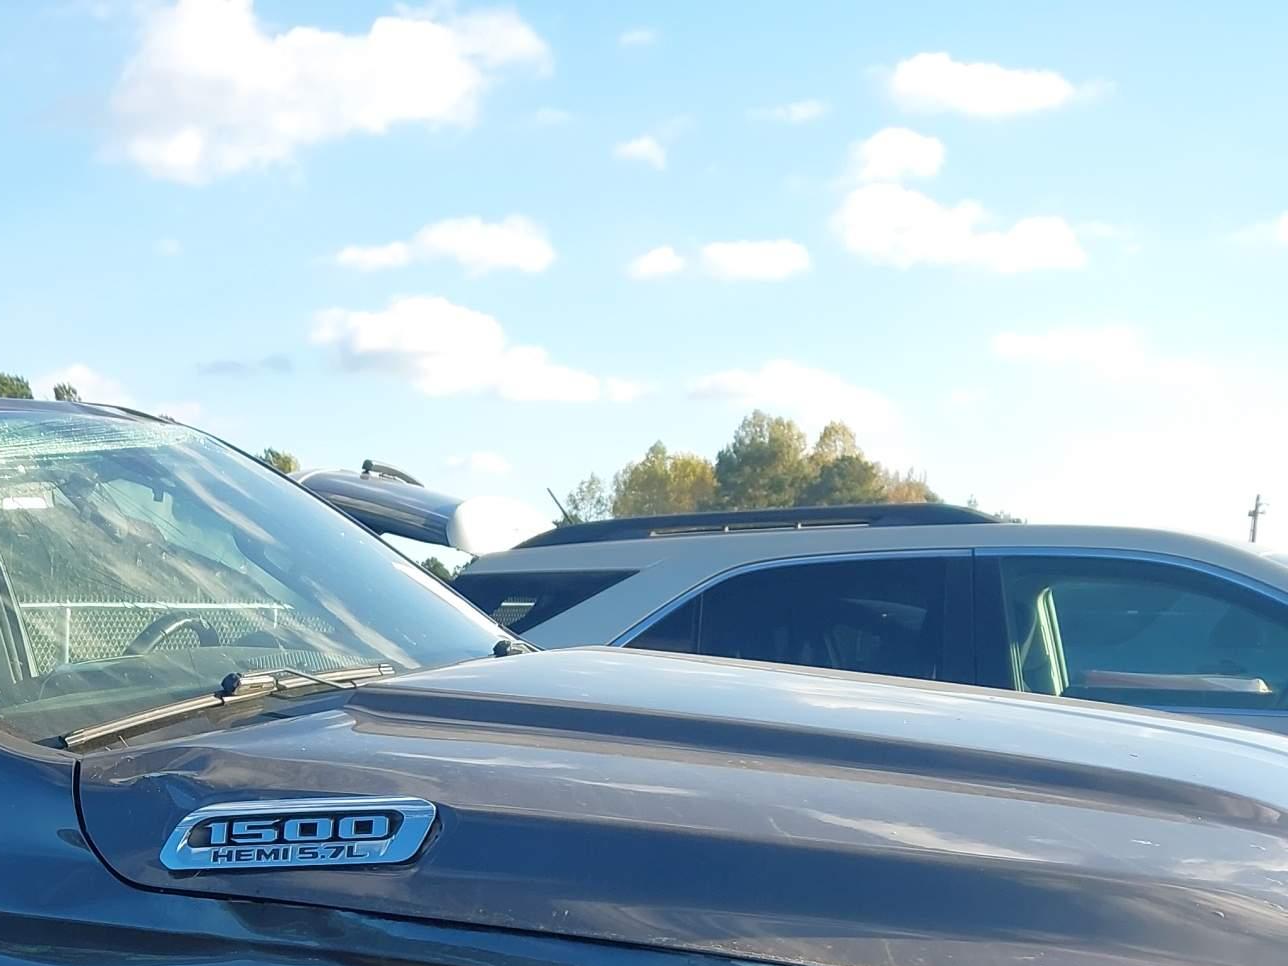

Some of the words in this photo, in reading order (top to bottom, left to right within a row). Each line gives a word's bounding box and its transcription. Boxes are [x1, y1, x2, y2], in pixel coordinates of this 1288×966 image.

[206, 815, 390, 845] 1500
[212, 847, 289, 863] HEMI
[298, 845, 368, 860] 5.7L
